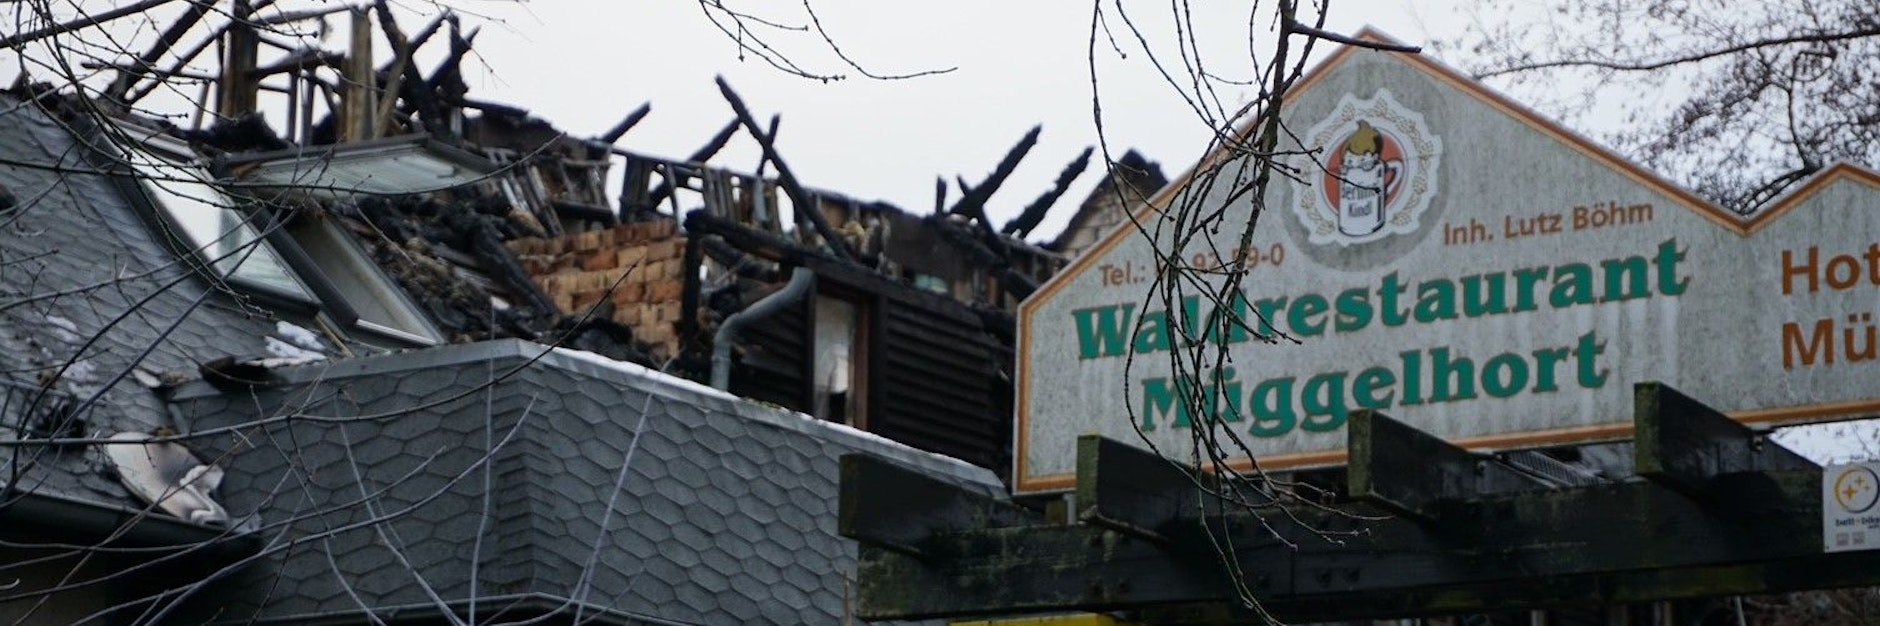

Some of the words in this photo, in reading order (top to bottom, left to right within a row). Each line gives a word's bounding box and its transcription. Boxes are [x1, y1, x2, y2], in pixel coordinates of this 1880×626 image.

[1444, 218, 1494, 245] Inh.
[1504, 213, 1563, 239] Lutz
[1573, 200, 1653, 231] Böhm
[1071, 237, 1691, 361] Waldrestaurant
[1098, 260, 1146, 286] Tel.:
[1141, 330, 1610, 438] Müggelhort
